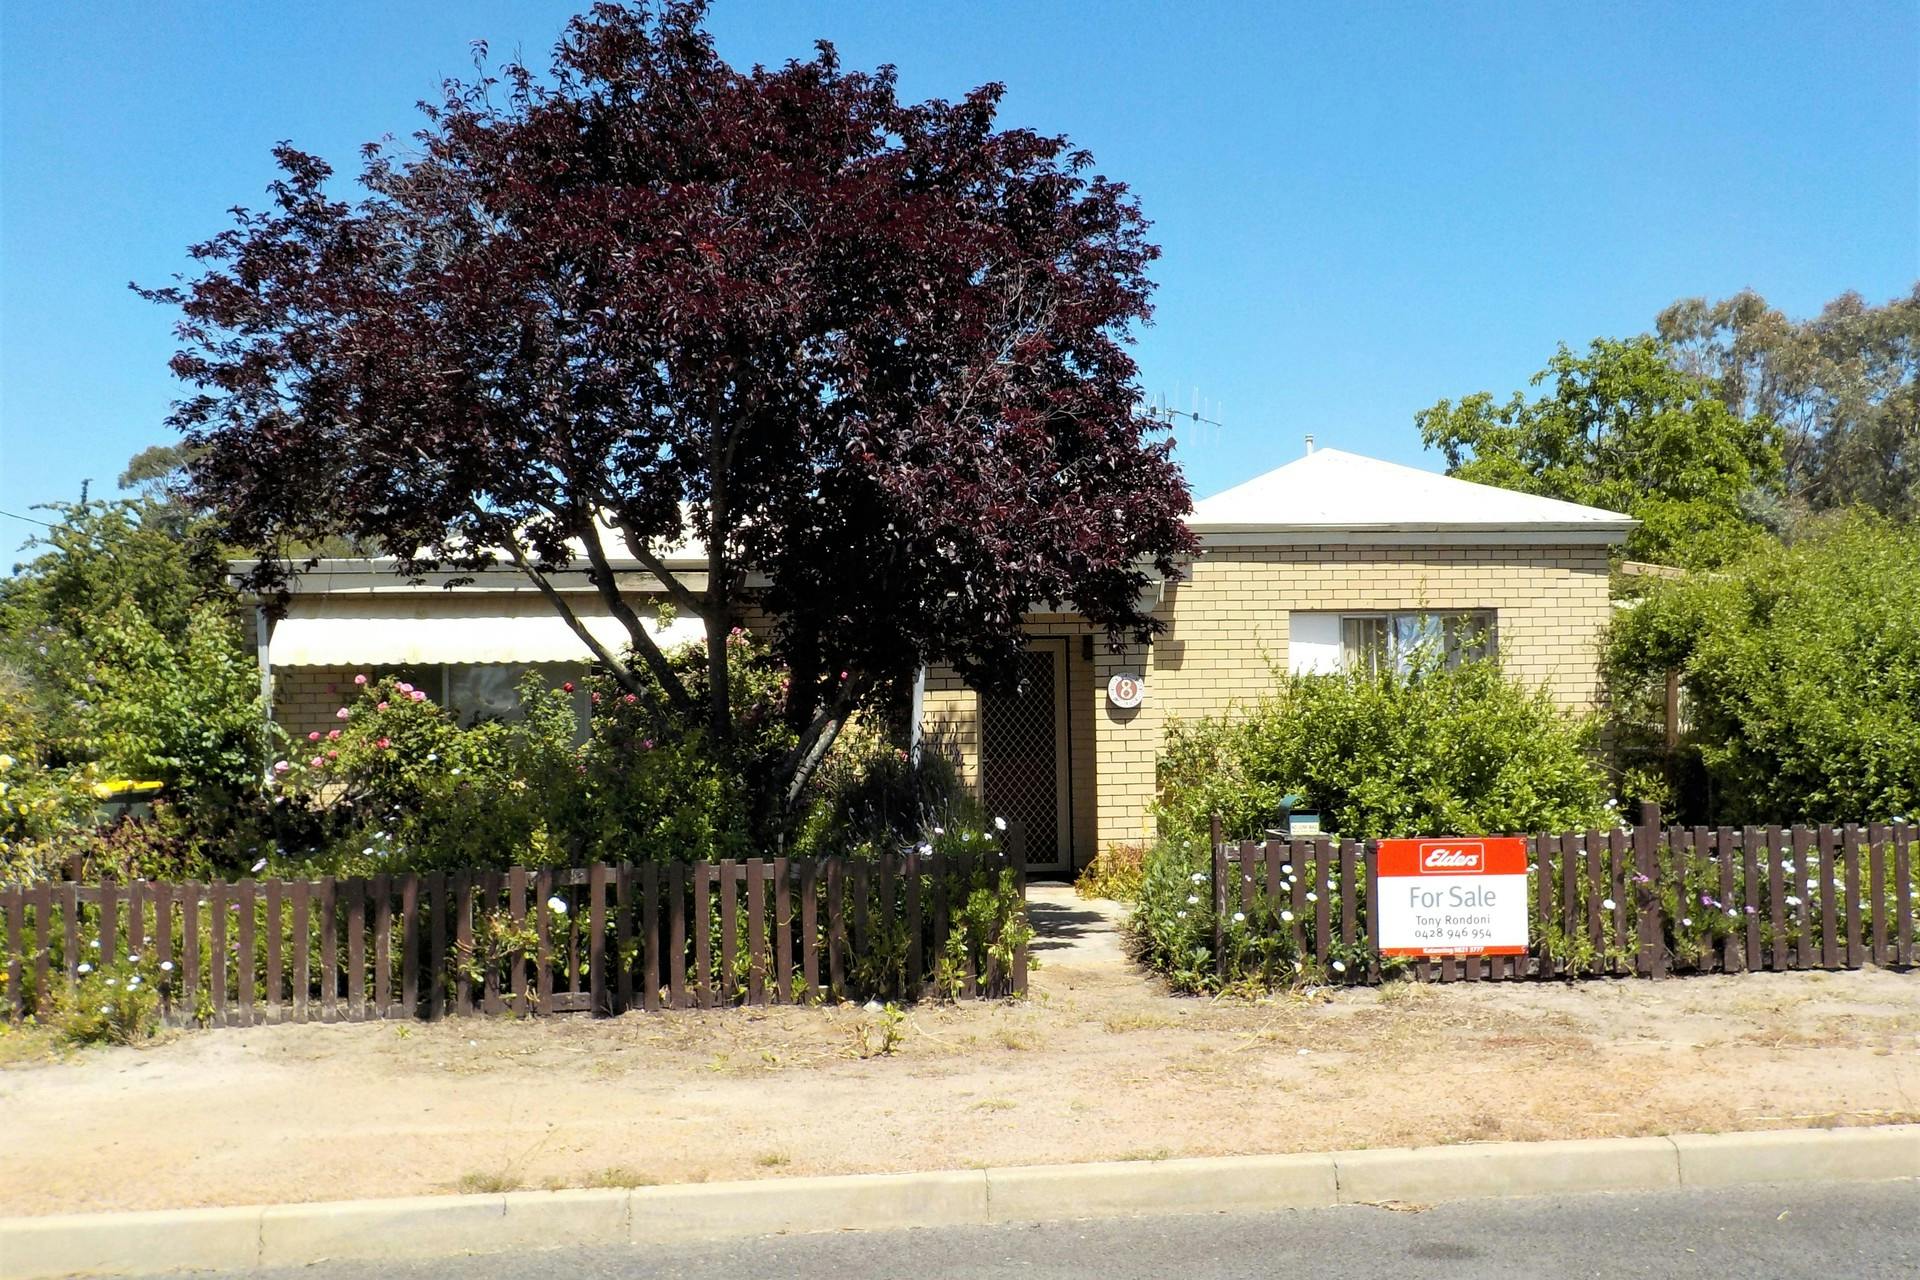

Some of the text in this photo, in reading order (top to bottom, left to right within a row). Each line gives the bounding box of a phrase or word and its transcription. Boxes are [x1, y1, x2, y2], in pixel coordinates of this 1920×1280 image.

[1120, 679, 1133, 699] 8
[1425, 849, 1479, 867] Elders
[1410, 885, 1496, 908] For Sale
[1415, 914, 1490, 927] Tony Rondoni
[1415, 927, 1492, 939] 0428 946 954
